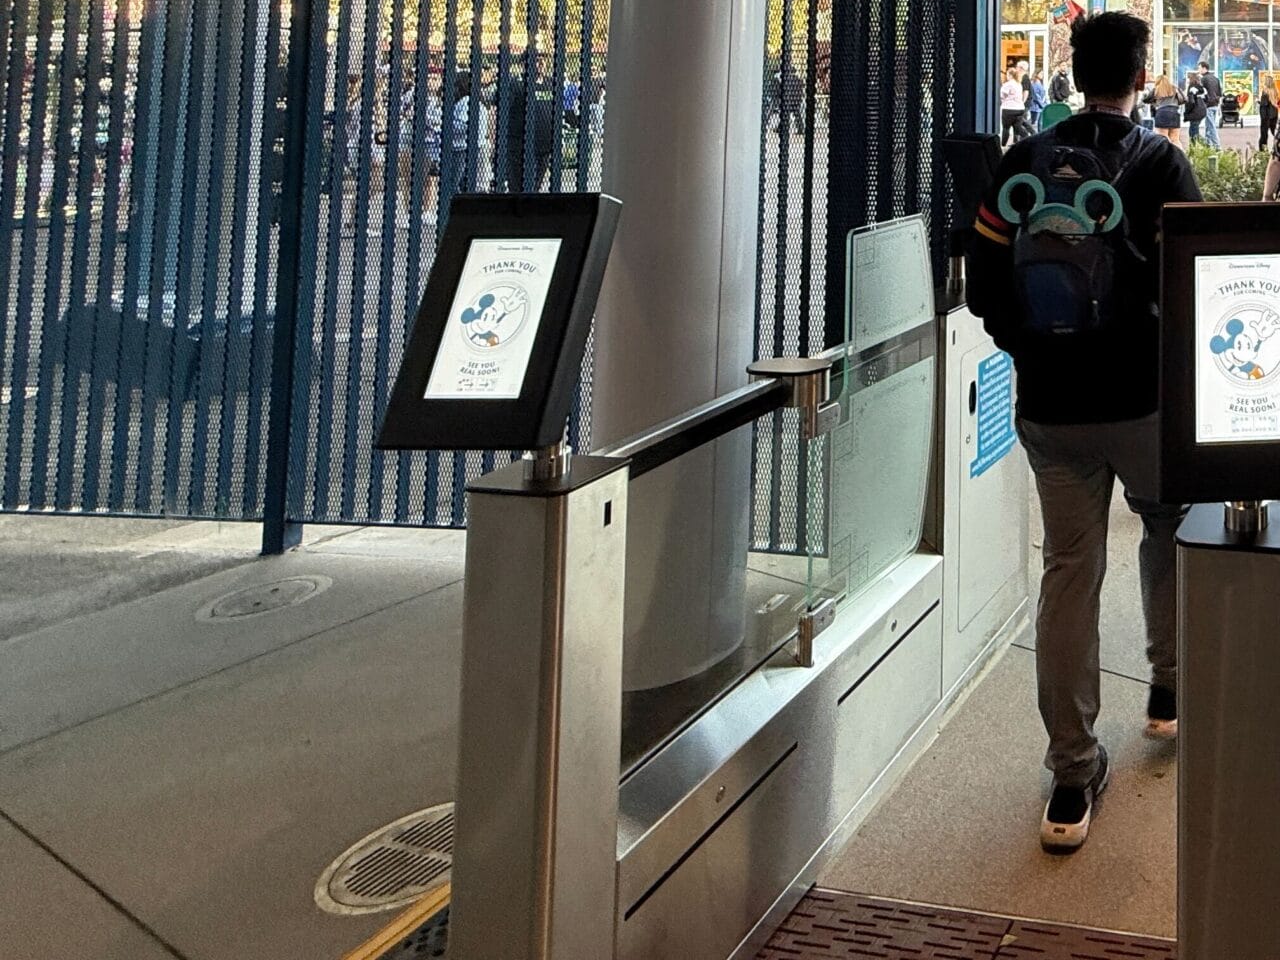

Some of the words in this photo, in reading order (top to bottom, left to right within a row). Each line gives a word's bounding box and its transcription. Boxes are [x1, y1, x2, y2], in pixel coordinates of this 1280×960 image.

[482, 260, 517, 273] THANK
[518, 261, 537, 273] YOU
[1218, 280, 1255, 295] THANK
[1259, 280, 1280, 294] YOU
[459, 366, 476, 375] REAL
[1236, 397, 1249, 405] SEE
[1251, 396, 1268, 405] YOU
[1228, 403, 1249, 413] REAL
